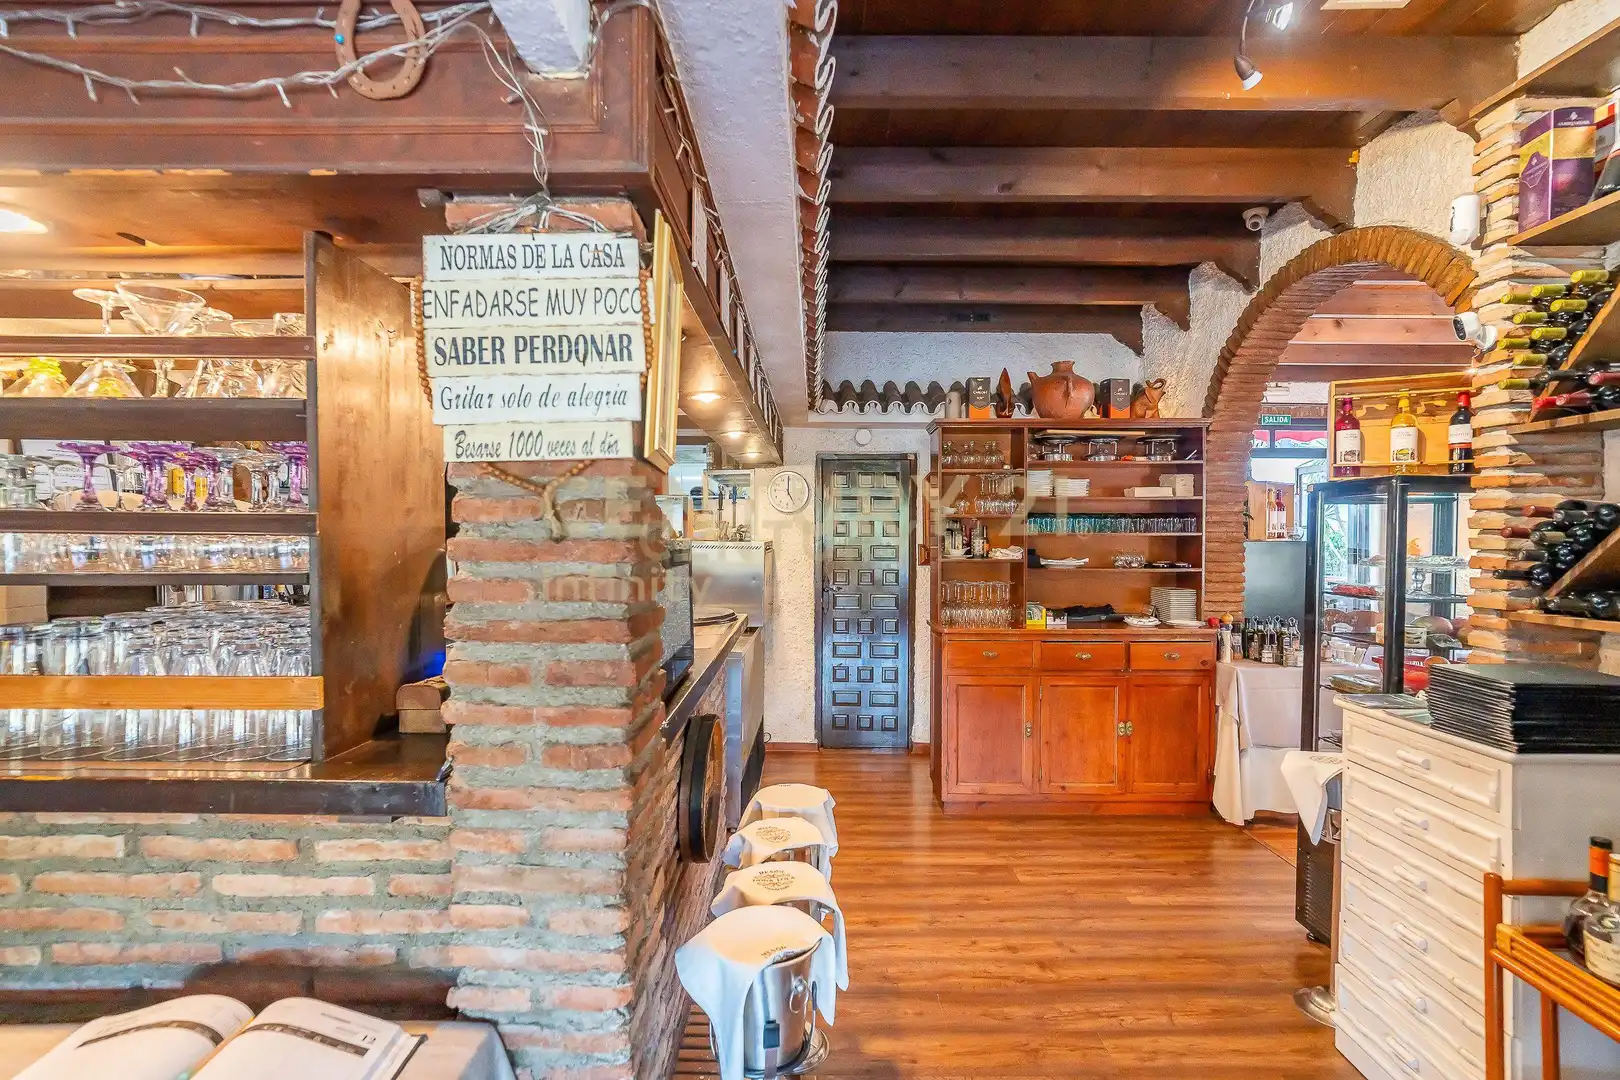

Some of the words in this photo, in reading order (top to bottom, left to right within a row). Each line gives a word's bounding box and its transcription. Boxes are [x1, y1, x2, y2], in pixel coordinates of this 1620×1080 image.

[440, 243, 517, 271] NORMAS
[522, 244, 546, 269] DE
[552, 244, 574, 268] LA
[579, 243, 625, 269] CASA
[423, 287, 538, 319] ENFADARSE
[545, 287, 588, 317] MUY
[594, 286, 641, 315] POCO
[434, 335, 505, 366] SABER
[514, 333, 633, 366] PERDONAR
[440, 384, 494, 411] Gritar
[500, 384, 531, 409] solo
[538, 384, 559, 409] de
[1264, 415, 1289, 424] SALIDA
[454, 430, 502, 459] Besarse
[509, 431, 543, 456] 1000
[547, 437, 577, 456] veces
[582, 431, 595, 455] al
